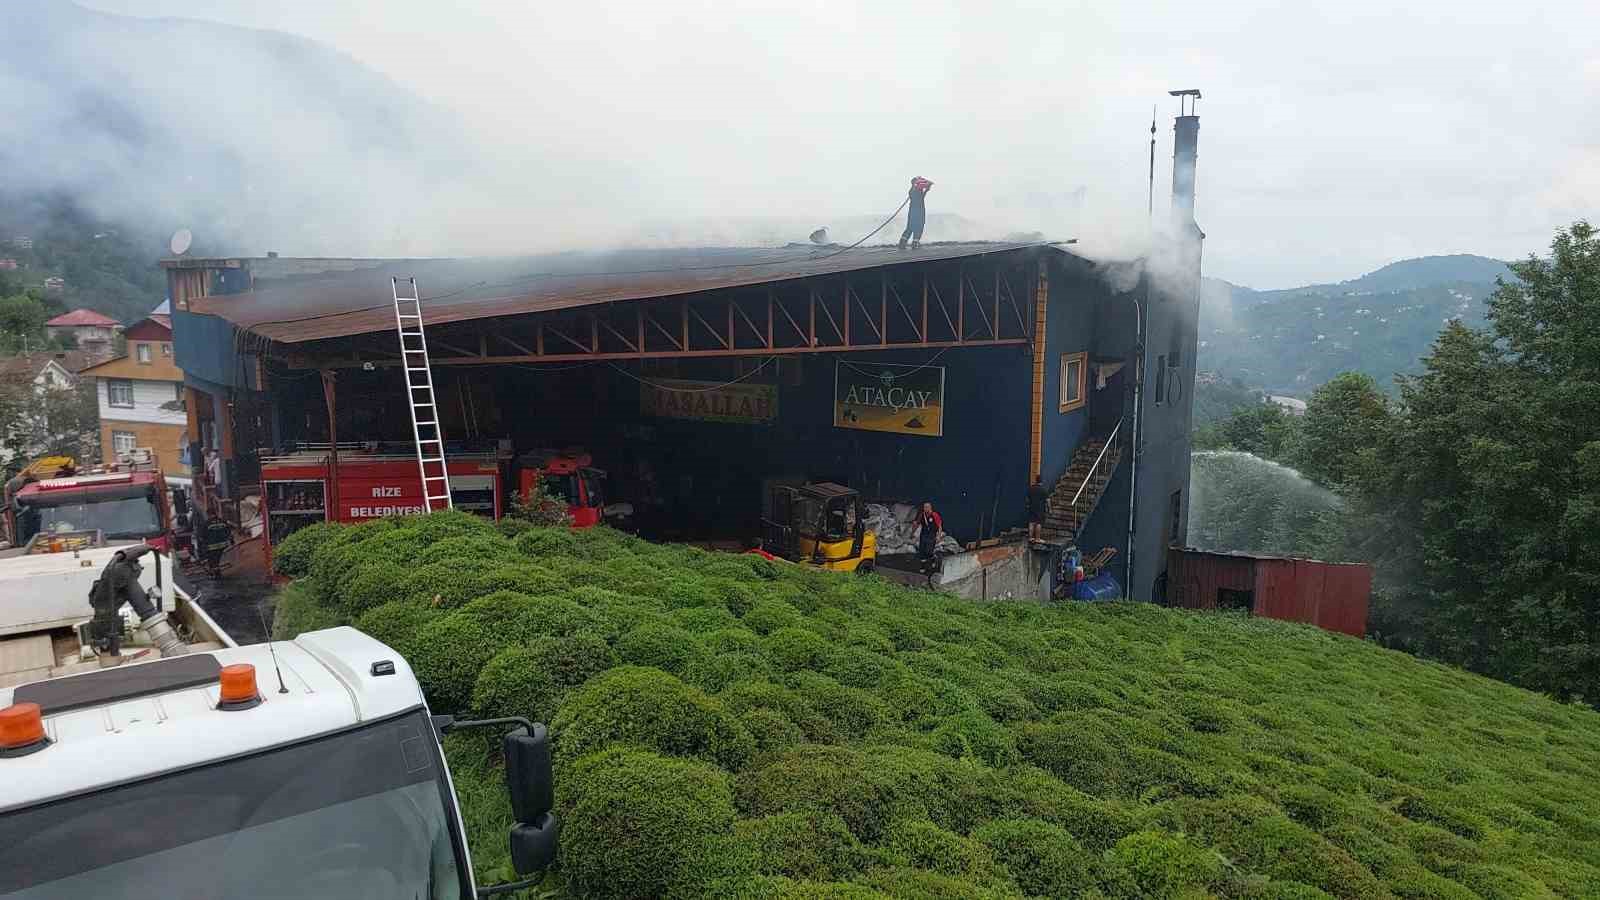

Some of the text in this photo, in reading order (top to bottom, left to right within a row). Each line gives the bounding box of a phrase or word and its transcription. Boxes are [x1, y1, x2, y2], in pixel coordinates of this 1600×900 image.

[845, 384, 932, 415] ATAÇAY
[372, 485, 402, 497] RİZE
[350, 504, 425, 517] BELEDİYESİ
